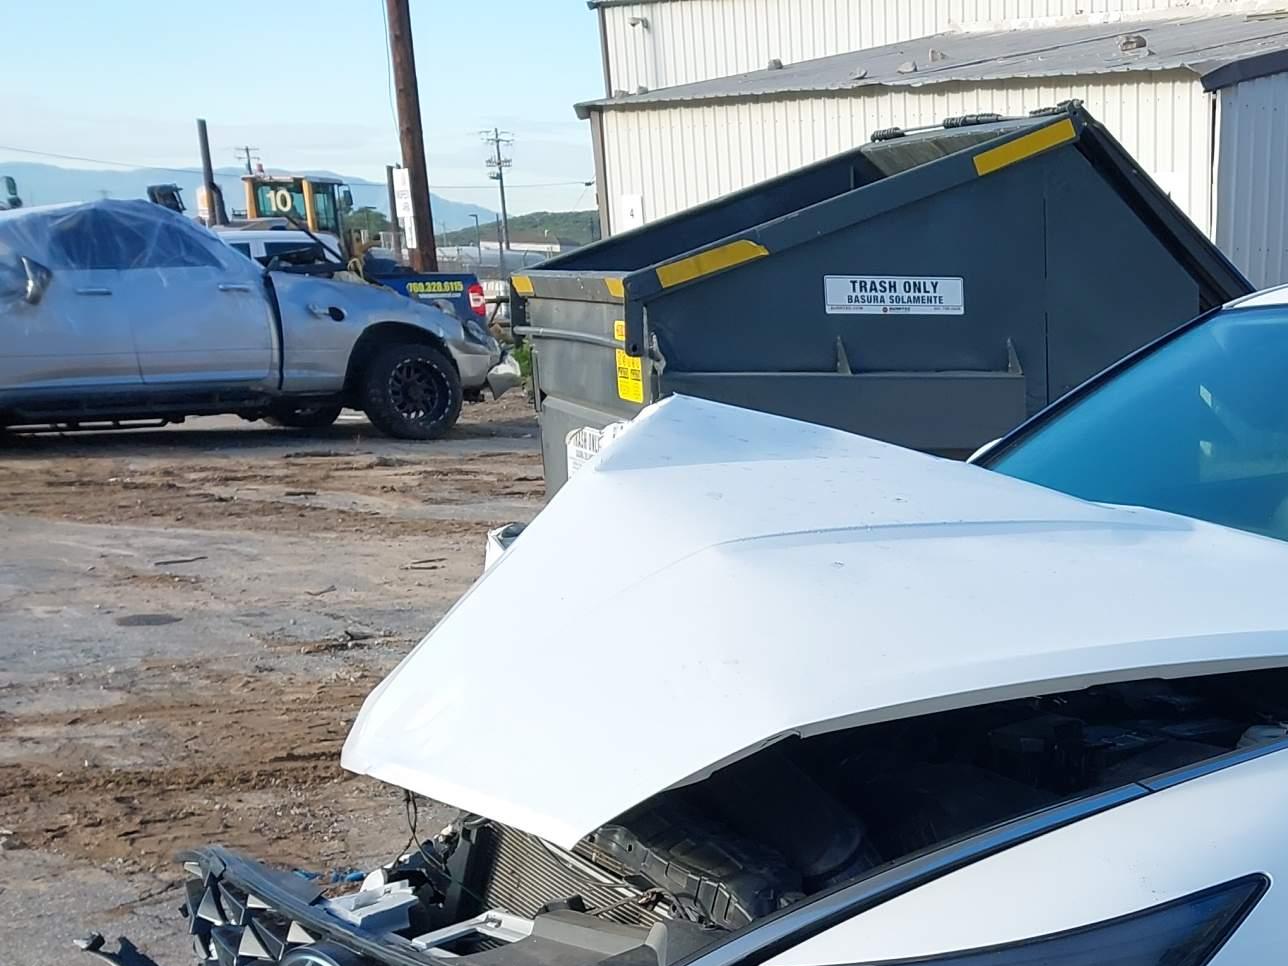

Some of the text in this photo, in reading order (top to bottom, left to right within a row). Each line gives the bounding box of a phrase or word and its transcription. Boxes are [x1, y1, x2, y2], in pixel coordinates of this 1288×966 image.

[266, 189, 292, 213] 10
[849, 279, 940, 294] TRASH ONLY
[847, 294, 944, 305] BASURA SOLAMENTE
